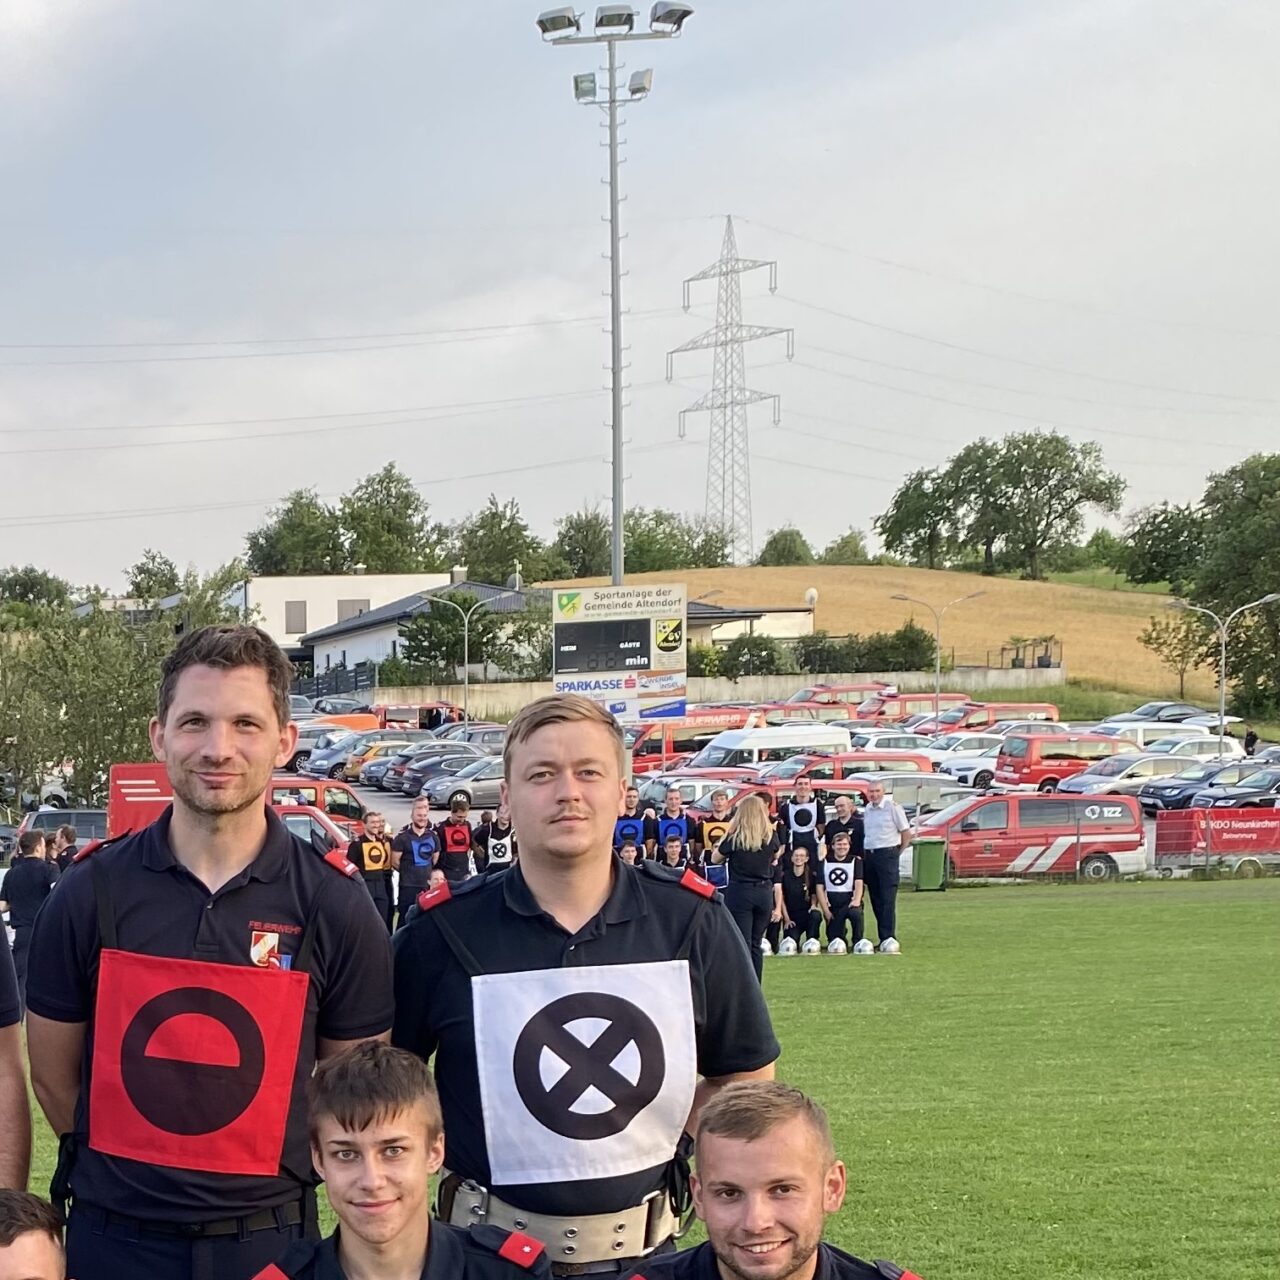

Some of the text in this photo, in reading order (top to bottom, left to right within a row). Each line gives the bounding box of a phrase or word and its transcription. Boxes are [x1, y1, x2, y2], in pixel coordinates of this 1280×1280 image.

[594, 588, 672, 601] Sportanlage der
[584, 598, 682, 611] Gemeinde Altendorf
[625, 656, 648, 666] min
[555, 679, 622, 692] SPARKASSE
